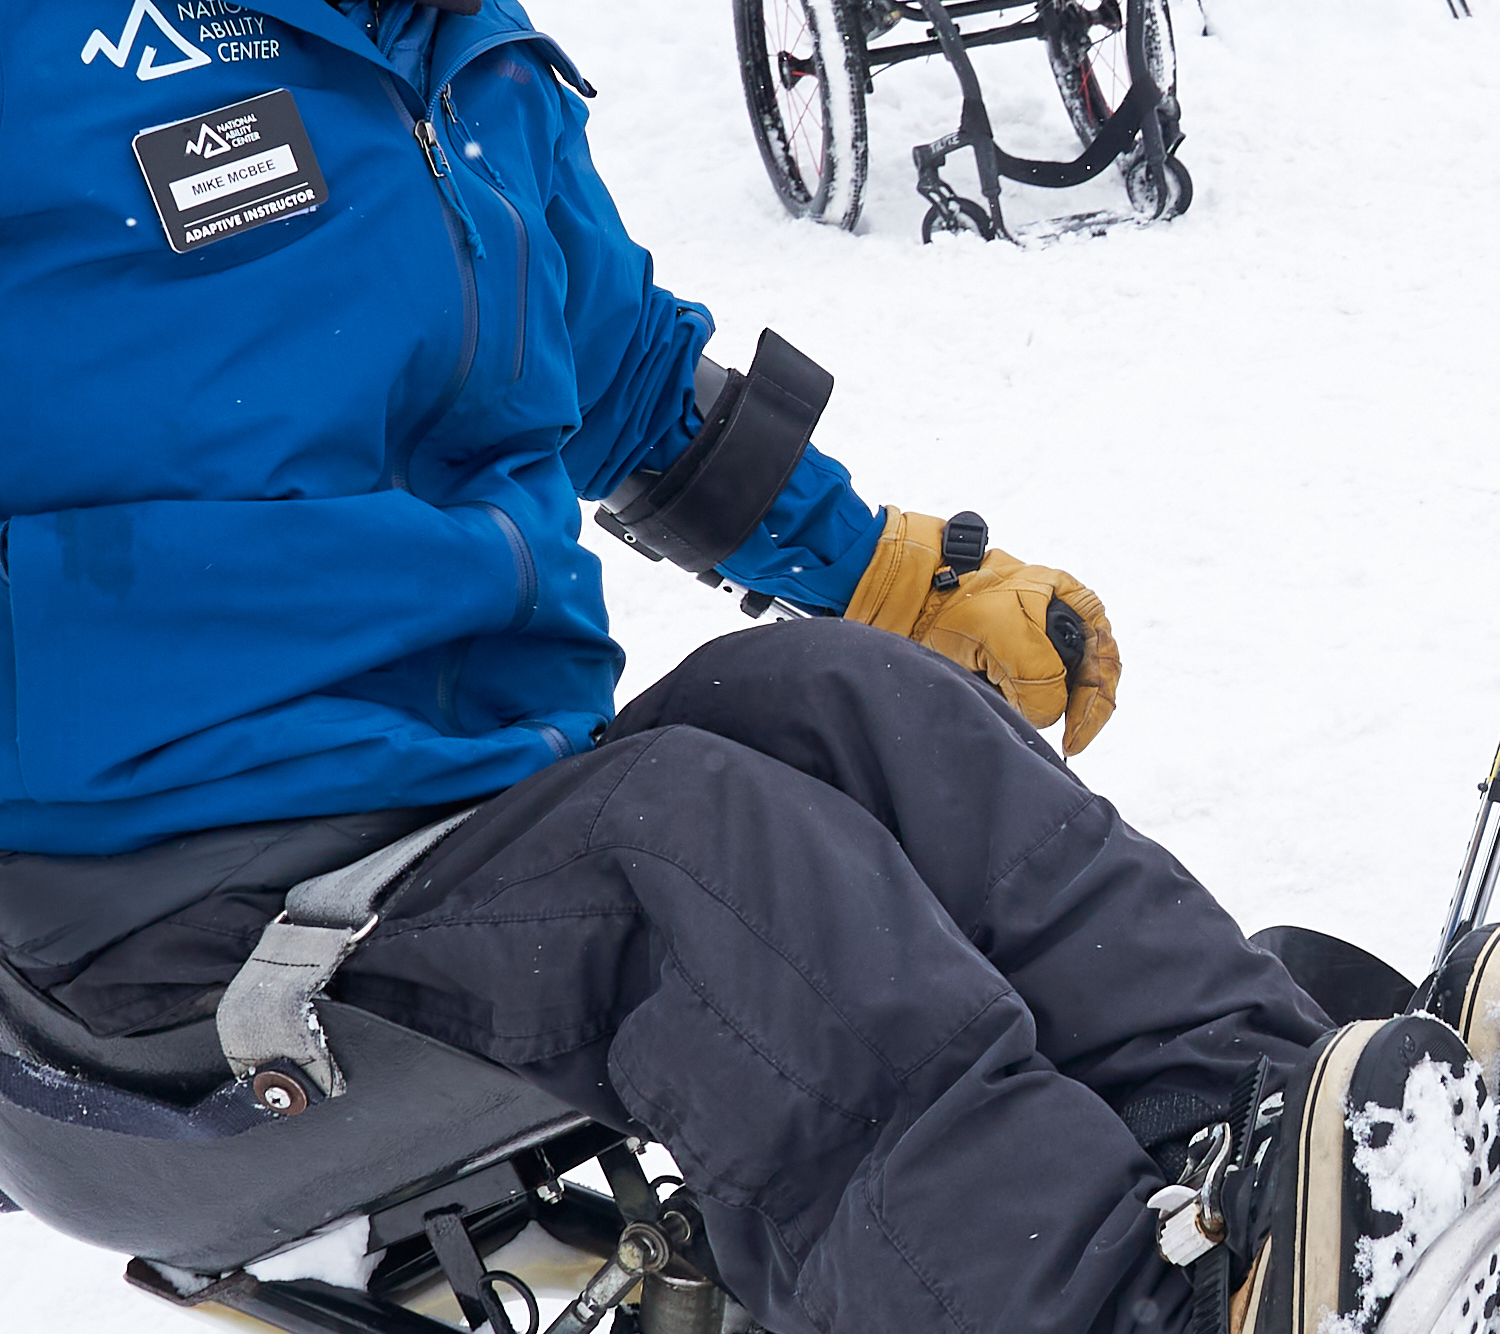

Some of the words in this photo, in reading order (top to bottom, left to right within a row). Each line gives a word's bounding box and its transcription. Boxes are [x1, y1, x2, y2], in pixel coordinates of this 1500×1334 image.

[200, 16, 265, 42] ABILITY
[217, 40, 280, 62] CENTER
[216, 113, 258, 134] NATIONAL
[225, 124, 252, 140] ABILITY
[231, 131, 261, 148] CENTER
[191, 176, 226, 196] MIKE
[227, 159, 276, 183] MCBEE
[185, 214, 242, 244] ADAPTIVE
[245, 188, 316, 223] INSTRUCTOR
